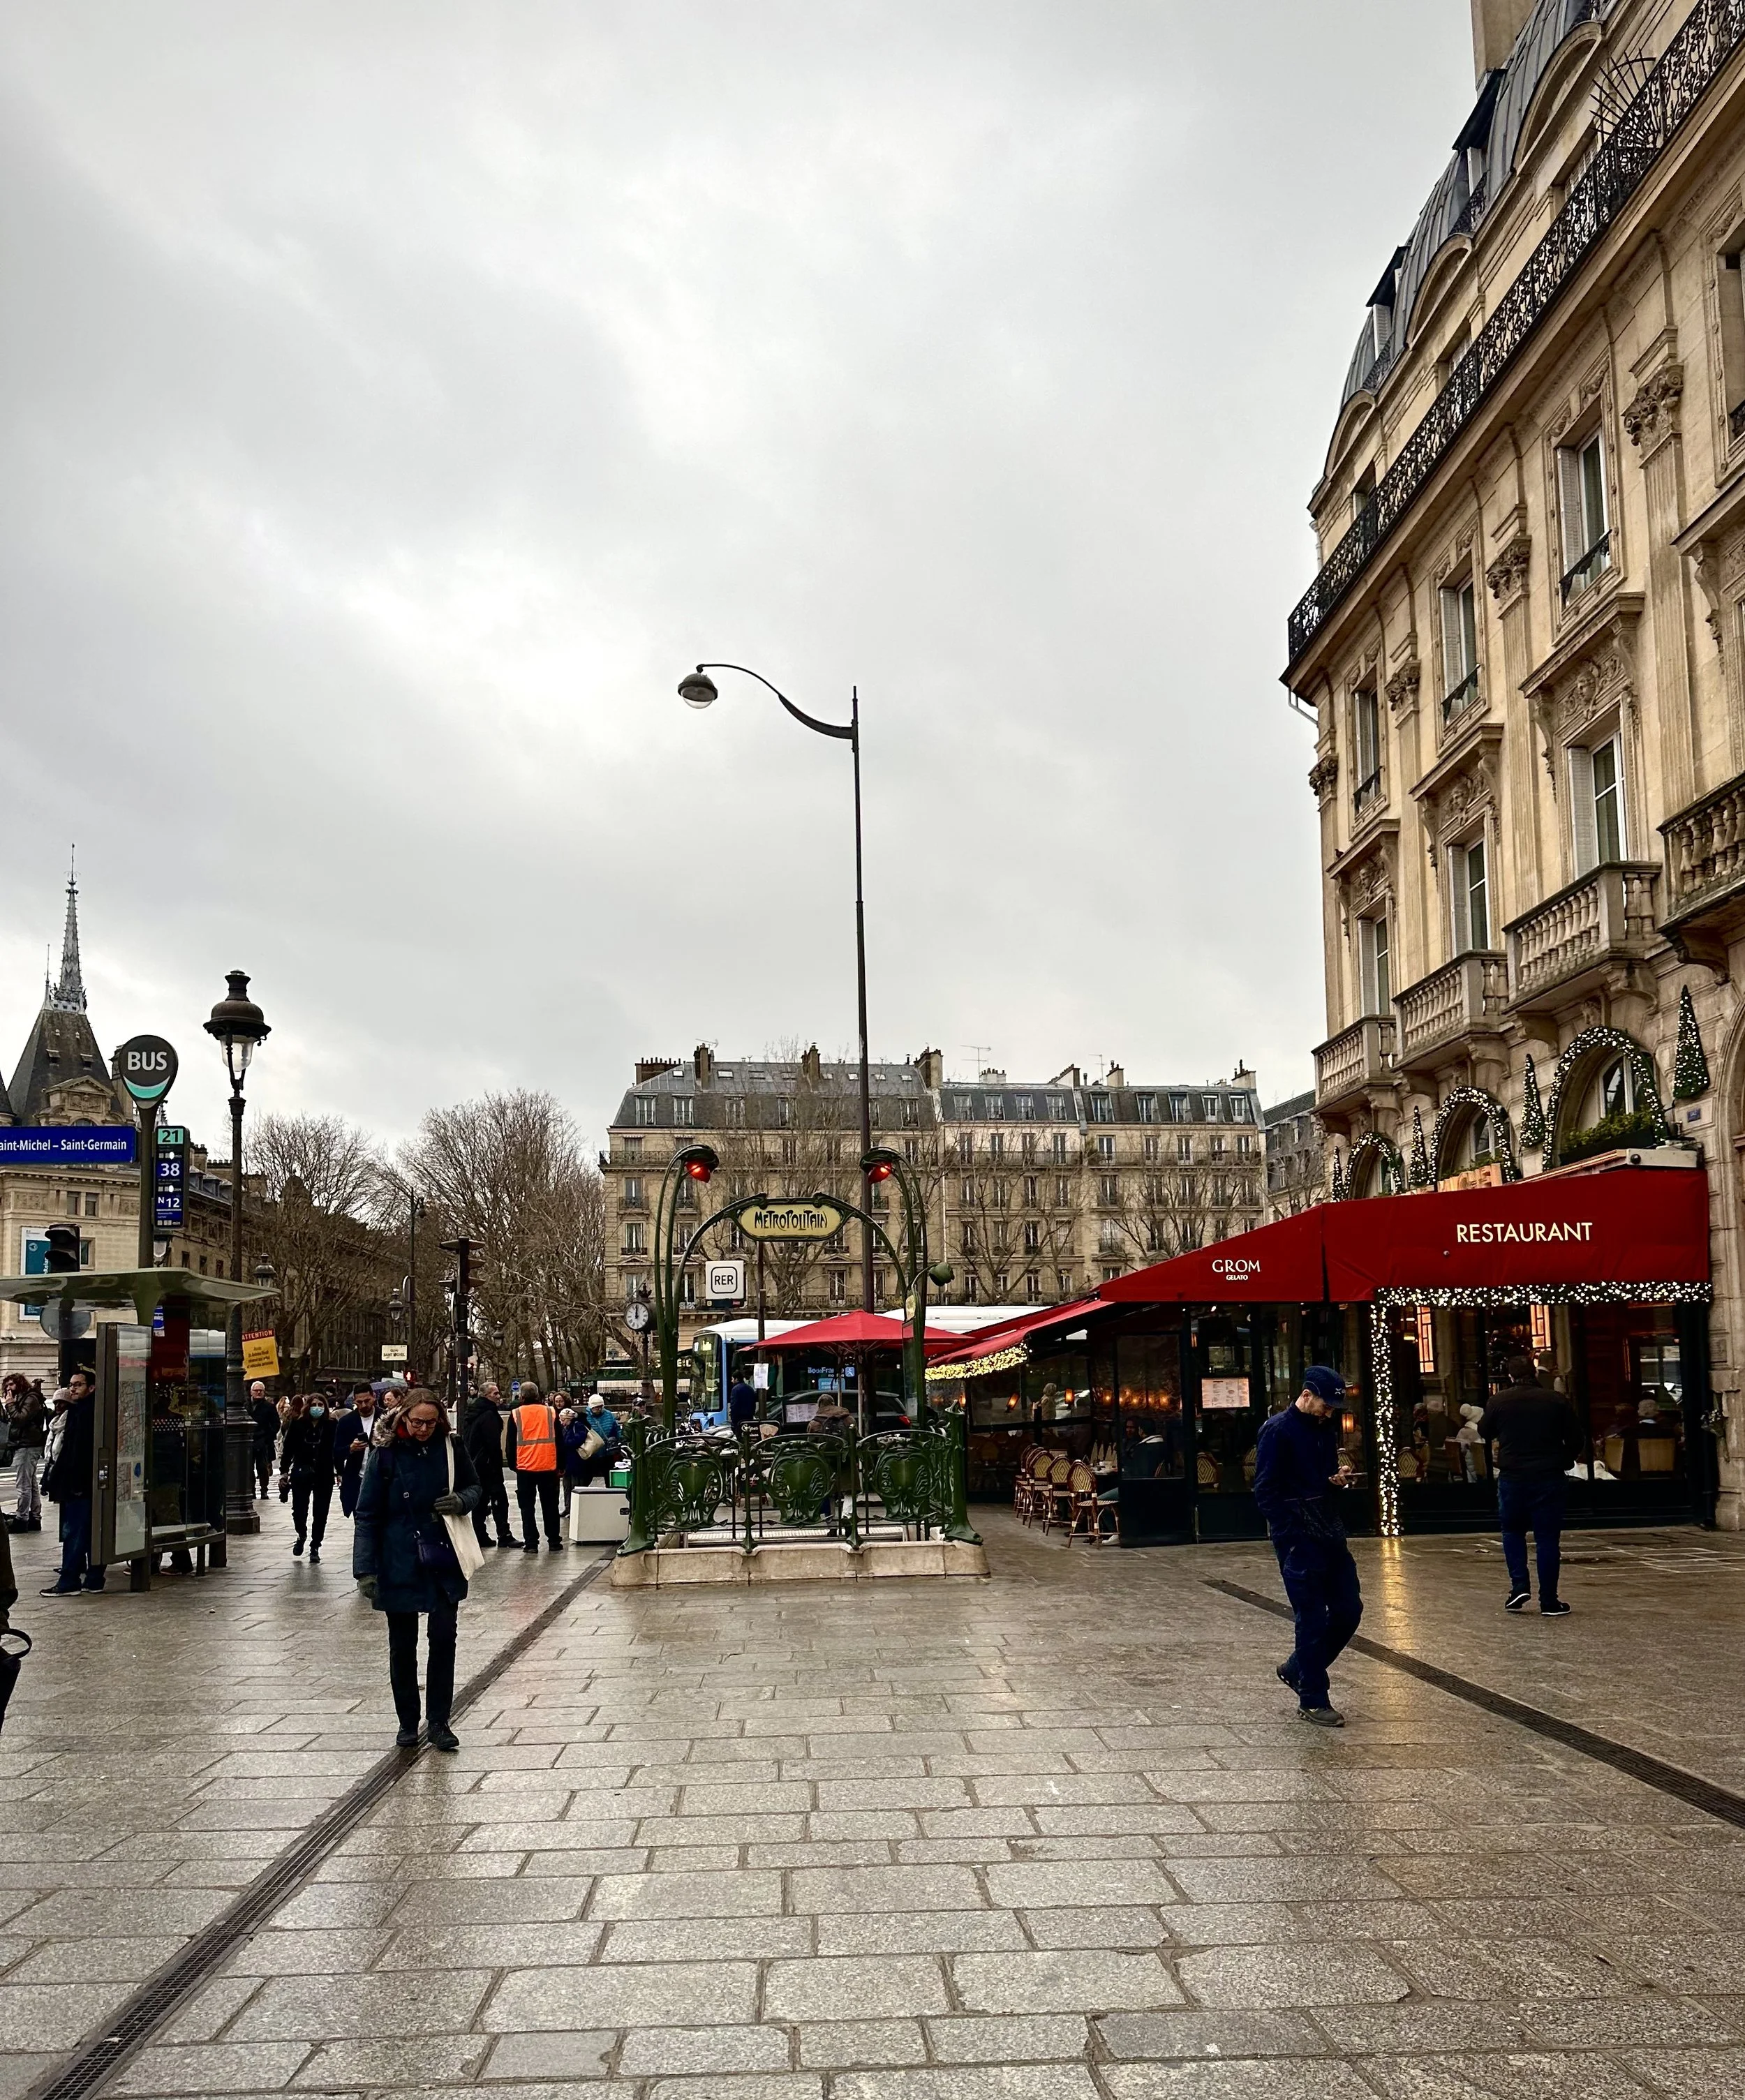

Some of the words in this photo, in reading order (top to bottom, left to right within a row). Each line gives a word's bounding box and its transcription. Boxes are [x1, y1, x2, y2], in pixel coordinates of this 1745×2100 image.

[127, 1051, 168, 1071] BUS
[161, 1129, 179, 1142] 21
[0, 1139, 50, 1151] aint-Michel
[61, 1138, 127, 1150] Saint-Germain
[161, 1163, 180, 1177] 38
[755, 1209, 828, 1231] METROPOLITAIN
[1457, 1222, 1593, 1243] RESTAURANT
[1212, 1259, 1261, 1273] GROM
[714, 1274, 734, 1286] RER
[242, 1330, 272, 1341] ATTENTION
